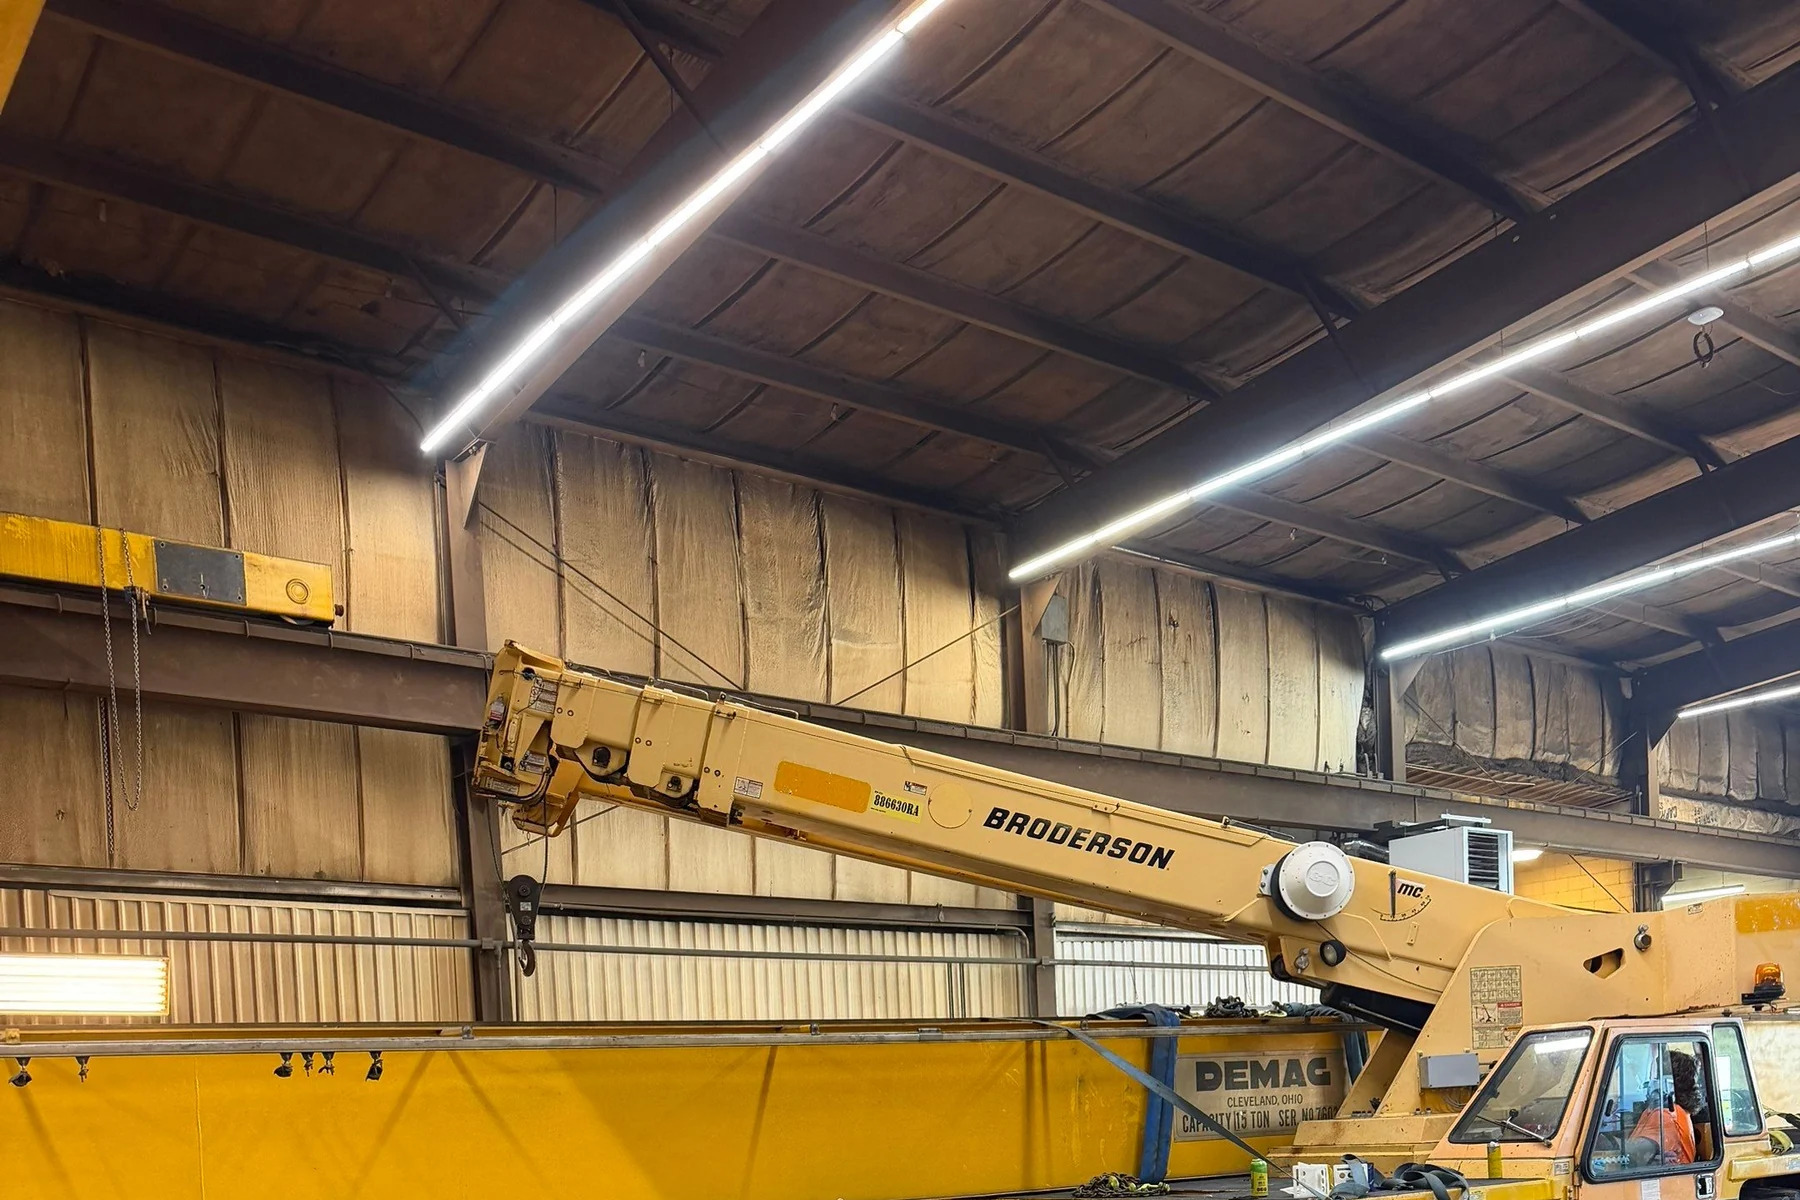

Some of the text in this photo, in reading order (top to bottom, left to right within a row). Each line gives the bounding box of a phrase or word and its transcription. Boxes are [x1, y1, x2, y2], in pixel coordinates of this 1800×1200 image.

[873, 794, 919, 817] 886630RA
[983, 807, 1175, 870] BRODERSON
[1196, 1057, 1331, 1091] DEMAG
[1227, 1094, 1303, 1108] CLEVELAND, OHIO
[1251, 1110, 1270, 1130] TON
